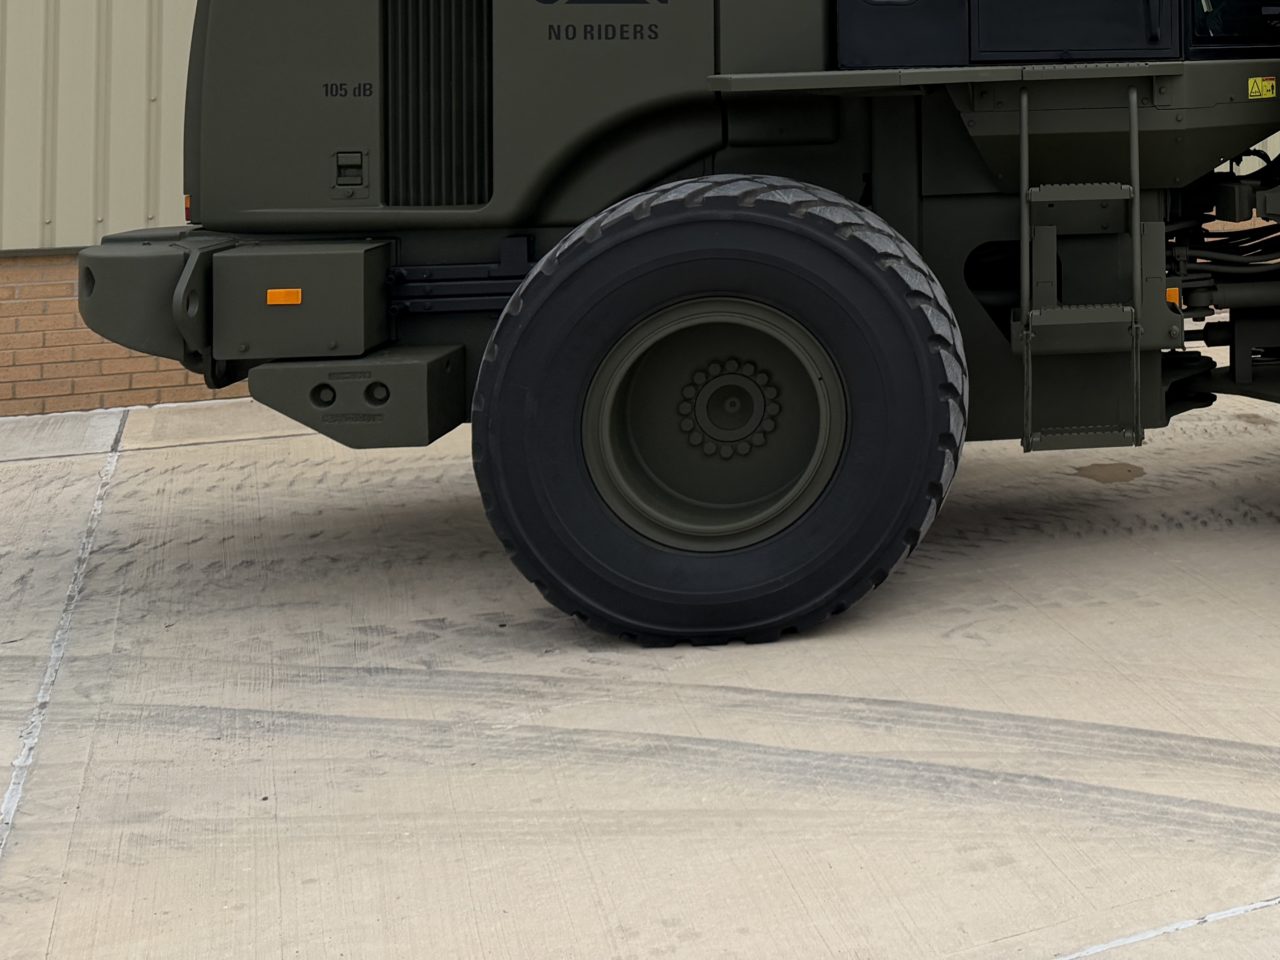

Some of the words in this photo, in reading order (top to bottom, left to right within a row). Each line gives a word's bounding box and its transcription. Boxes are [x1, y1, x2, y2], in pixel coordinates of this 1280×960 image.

[548, 24, 577, 41] NO
[584, 24, 659, 41] RIDERS
[322, 83, 348, 97] 105
[353, 83, 373, 97] dB
